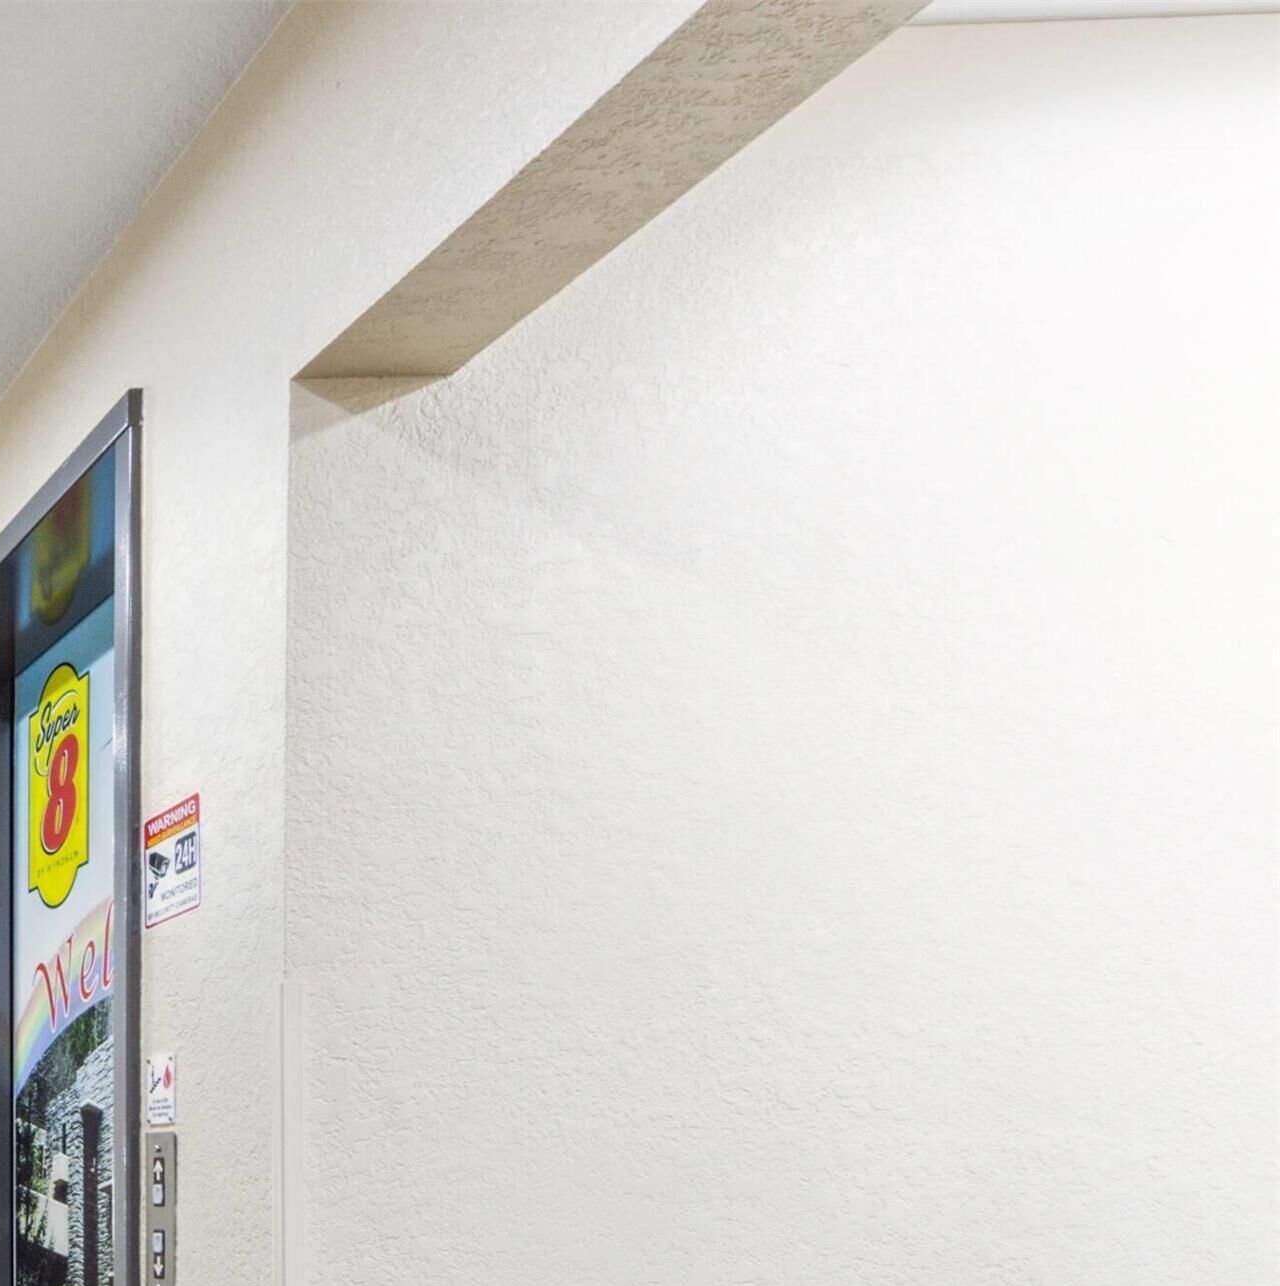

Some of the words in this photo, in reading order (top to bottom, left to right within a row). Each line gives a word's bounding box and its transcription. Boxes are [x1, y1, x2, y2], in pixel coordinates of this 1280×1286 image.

[35, 700, 80, 767] Super
[41, 733, 79, 854] 8
[147, 799, 197, 837] WARNING
[175, 835, 197, 871] 24H
